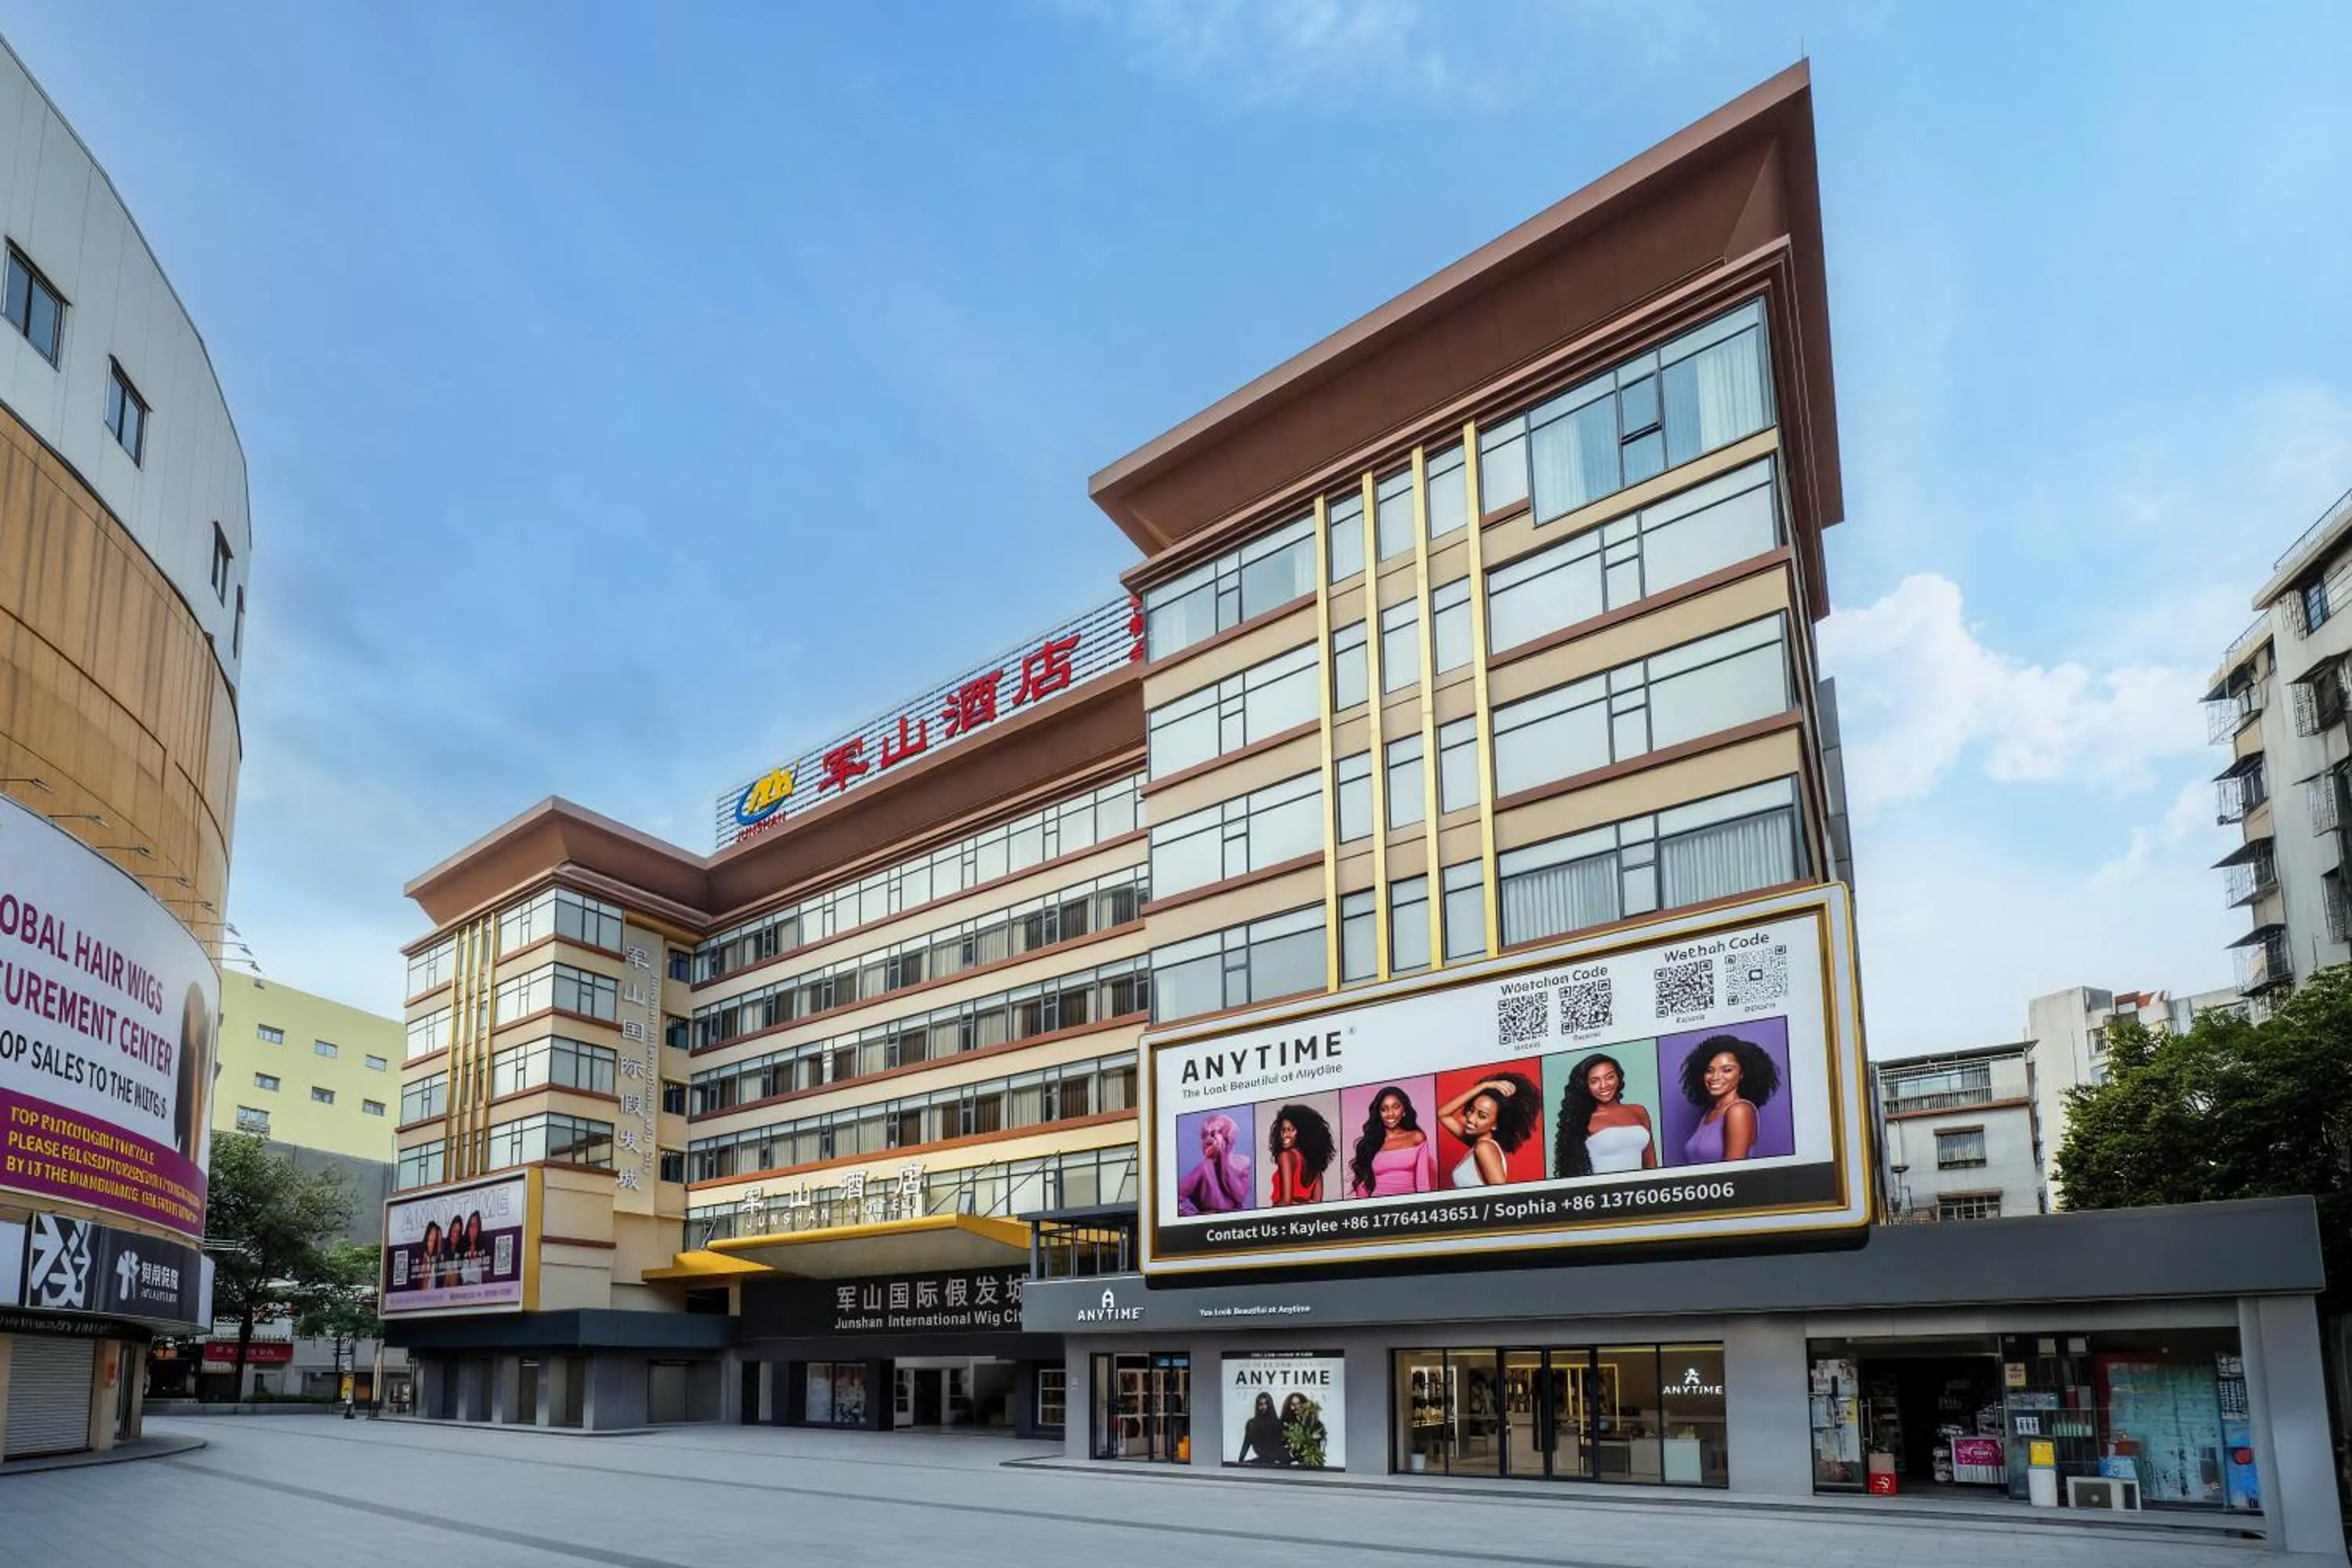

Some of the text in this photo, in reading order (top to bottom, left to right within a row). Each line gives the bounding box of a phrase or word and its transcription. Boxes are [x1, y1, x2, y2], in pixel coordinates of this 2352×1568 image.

[818, 633, 1080, 793] 军山酒店
[0, 894, 163, 1015] OBAL HAIR WIGS
[1729, 932, 1769, 949] Code
[1572, 966, 1608, 981] Code
[0, 959, 173, 1076] UREMENT CENTER
[0, 1029, 27, 1062] OP
[31, 1041, 85, 1083] SALES
[89, 1062, 107, 1092] TO
[110, 1071, 133, 1104] THE
[615, 946, 650, 1191] 军山国际假发城
[1181, 1030, 1342, 1083] ANYTIME
[1182, 1088, 1200, 1099] The
[10, 1105, 38, 1126] TOP
[8, 1131, 60, 1159] PLEASE
[6, 1156, 24, 1173] BY
[45, 1164, 70, 1184] THE
[742, 1163, 923, 1214] 军山酒店
[746, 1208, 829, 1229] JUNSHAN
[1207, 1226, 1258, 1242] Contact
[1261, 1224, 1278, 1236] Us
[1290, 1218, 1339, 1236] Kaylee
[1341, 1216, 1369, 1229] +86
[1373, 1205, 1479, 1229] 17764143651
[1494, 1198, 1557, 1219] Sophia
[1561, 1194, 1595, 1210] +86
[1599, 1181, 1735, 1209] 13760656006
[837, 1273, 1029, 1312] 军山国际假发城
[835, 1316, 883, 1329] Junshan
[888, 1311, 971, 1327] International
[975, 1311, 1000, 1326] Wig
[1077, 1307, 1141, 1321] ANYTIME
[1236, 1370, 1330, 1385] ANYTIME
[1662, 1385, 1723, 1395] ANYTIME
